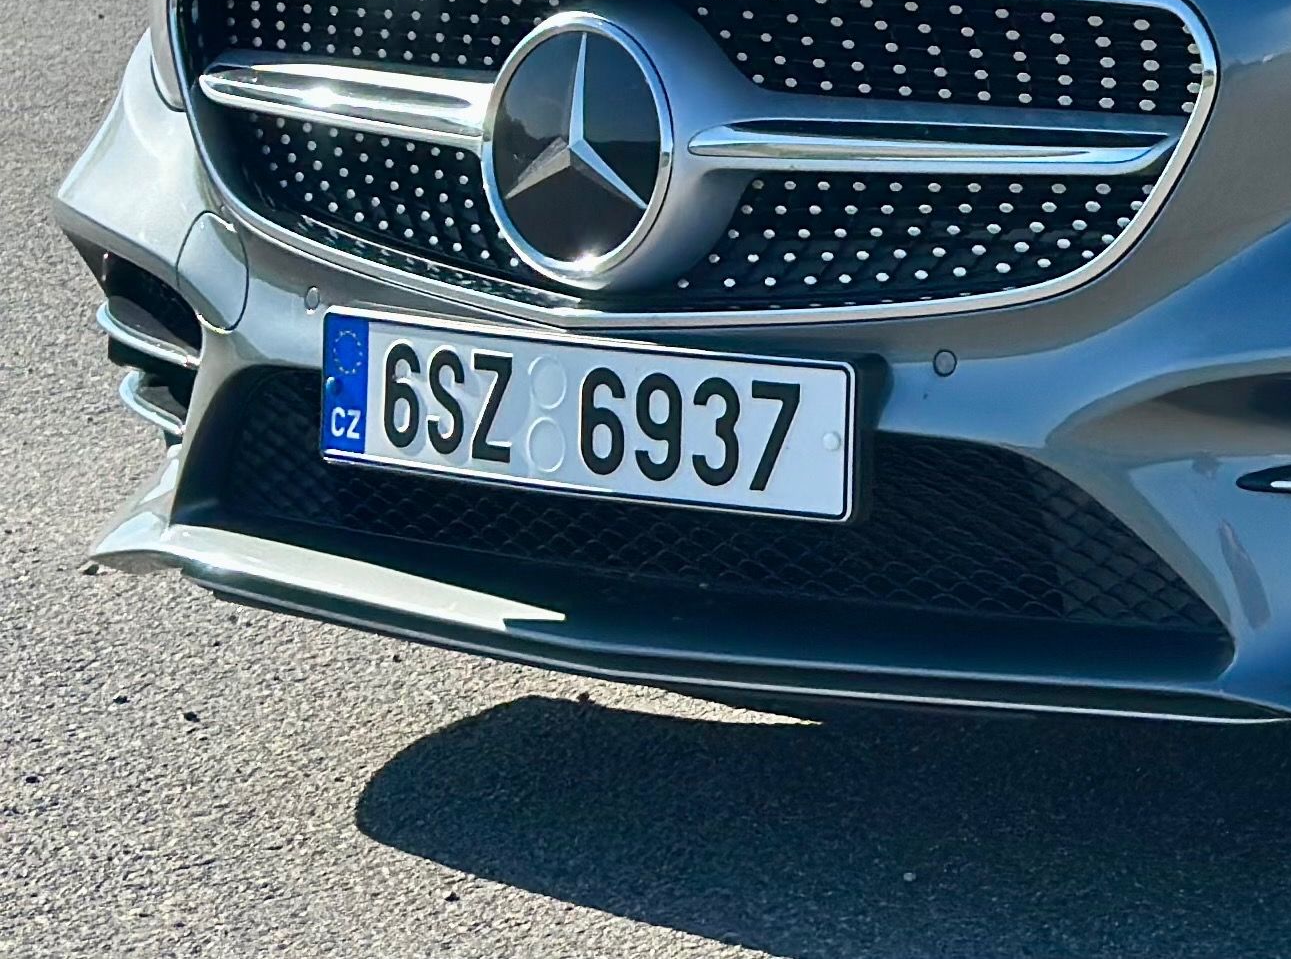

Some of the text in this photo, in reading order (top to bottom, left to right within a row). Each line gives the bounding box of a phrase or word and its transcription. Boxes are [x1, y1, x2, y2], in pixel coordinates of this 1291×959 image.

[330, 409, 361, 440] CZ
[383, 341, 802, 492] 6SZ 6937
